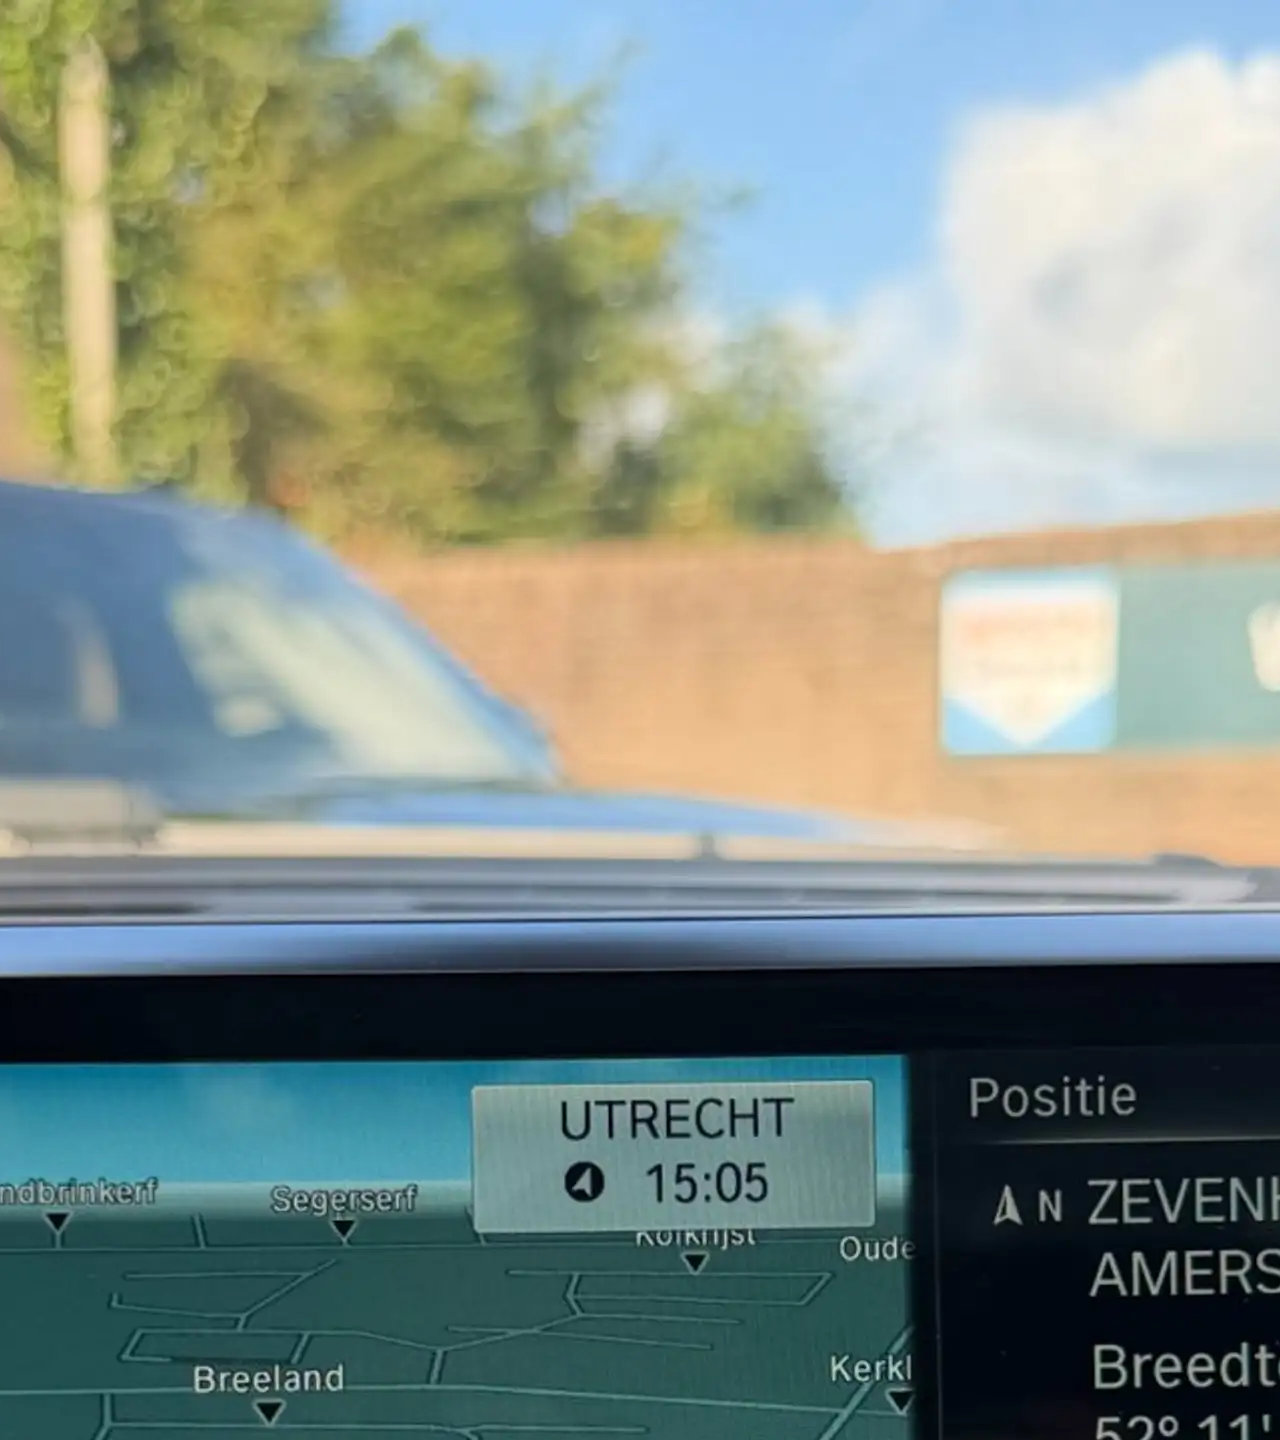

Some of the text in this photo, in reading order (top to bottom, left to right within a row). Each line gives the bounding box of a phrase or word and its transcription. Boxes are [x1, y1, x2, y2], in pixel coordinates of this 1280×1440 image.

[969, 1075, 1137, 1118] Positie
[560, 1097, 795, 1141] UTRECHT
[645, 1161, 769, 1204] 15:05
[271, 1184, 419, 1219] Segerserf
[1038, 1189, 1063, 1222] N
[193, 1364, 344, 1394] Breeland
[830, 1354, 912, 1382] Kerkl
